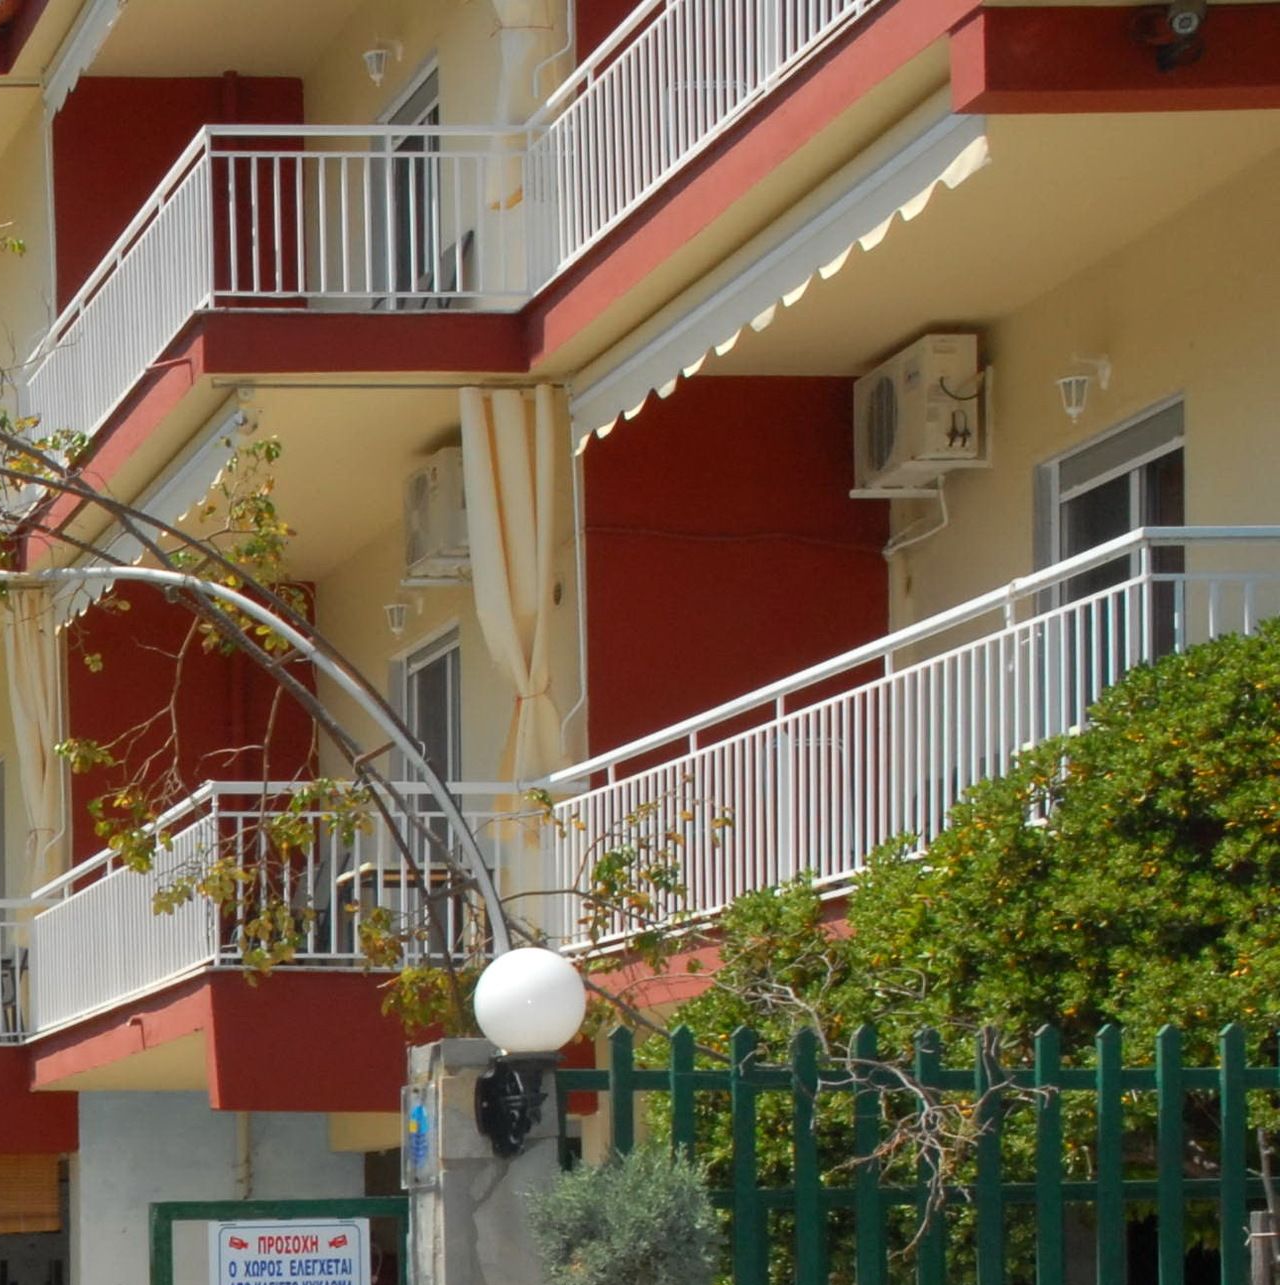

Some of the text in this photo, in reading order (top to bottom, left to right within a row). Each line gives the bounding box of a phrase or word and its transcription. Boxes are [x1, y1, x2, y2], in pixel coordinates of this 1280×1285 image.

[257, 1235, 319, 1254] ΠΡΟΣΟΧΗ
[228, 1258, 352, 1278] Ο ΧΩΡΟΣ ΕΛΕΓΧΕΤΑΙ
